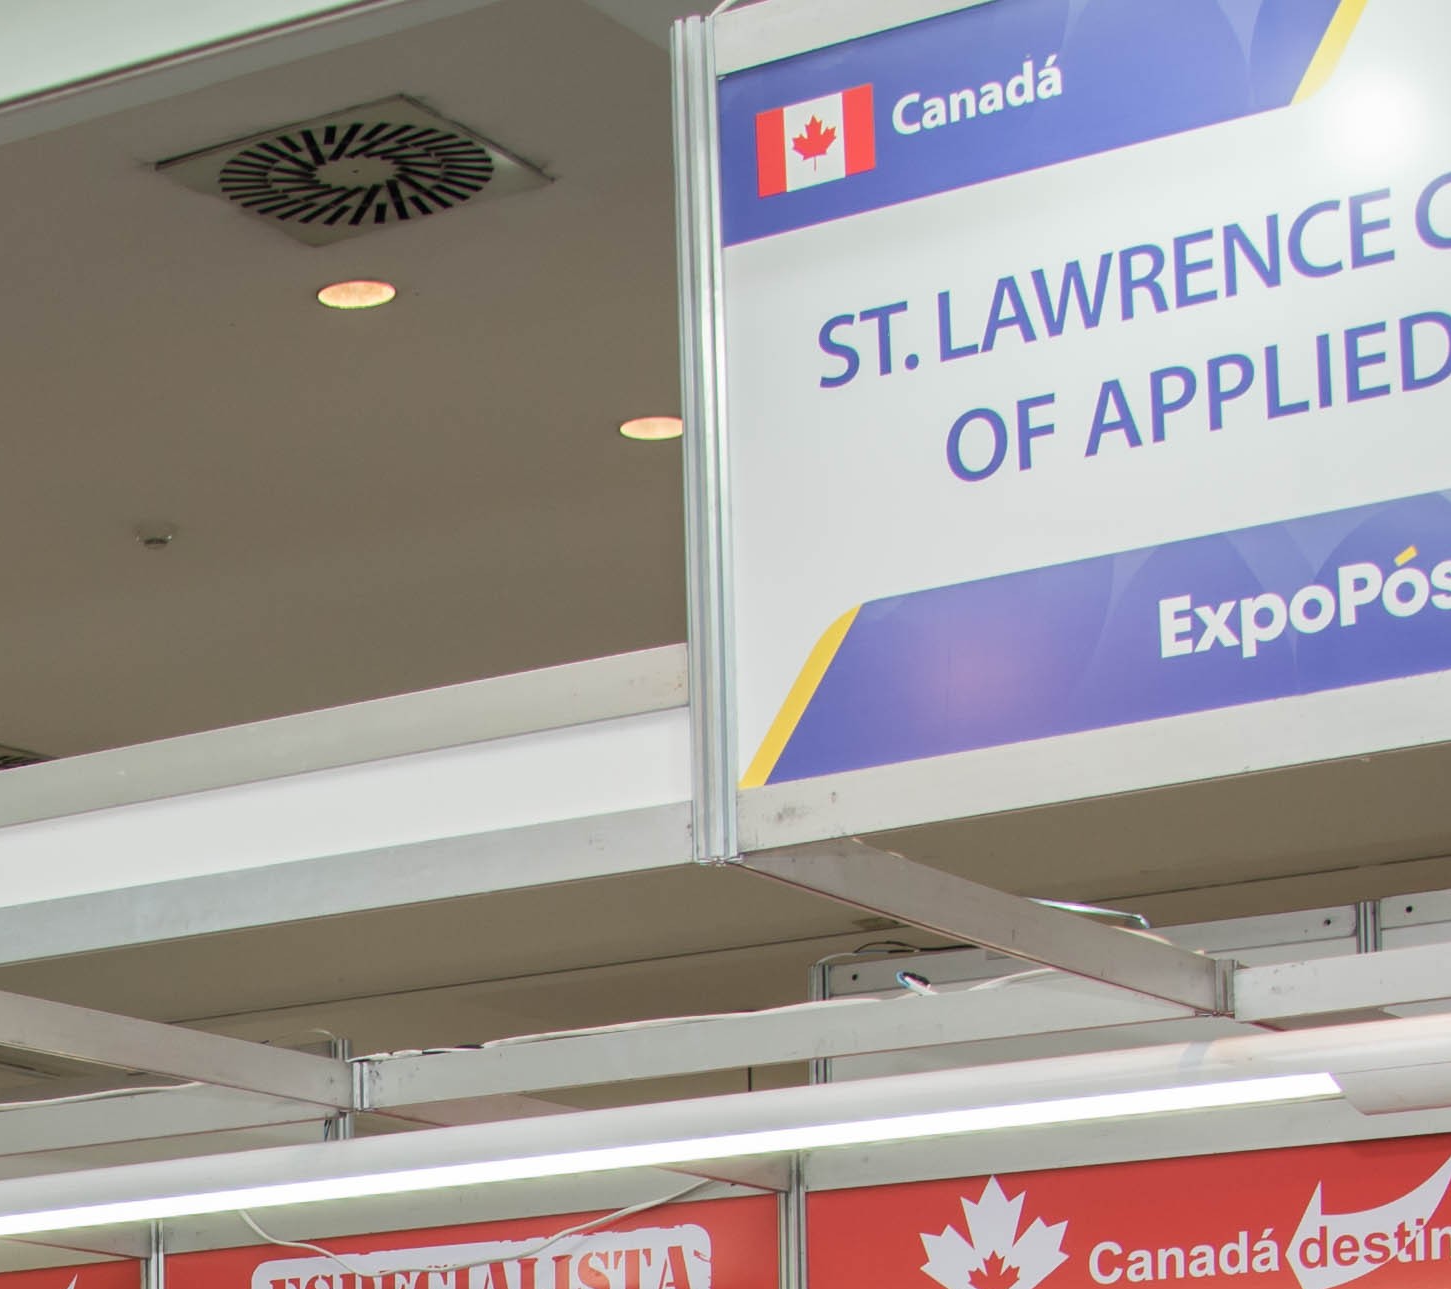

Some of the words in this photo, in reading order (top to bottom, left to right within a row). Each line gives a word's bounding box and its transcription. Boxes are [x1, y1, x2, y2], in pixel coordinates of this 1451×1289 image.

[891, 54, 1064, 137] Canadá
[816, 299, 922, 388] ST.
[935, 190, 1396, 360] LAWRENCE
[944, 391, 1055, 482] OF
[1090, 1228, 1280, 1285] Canadá
